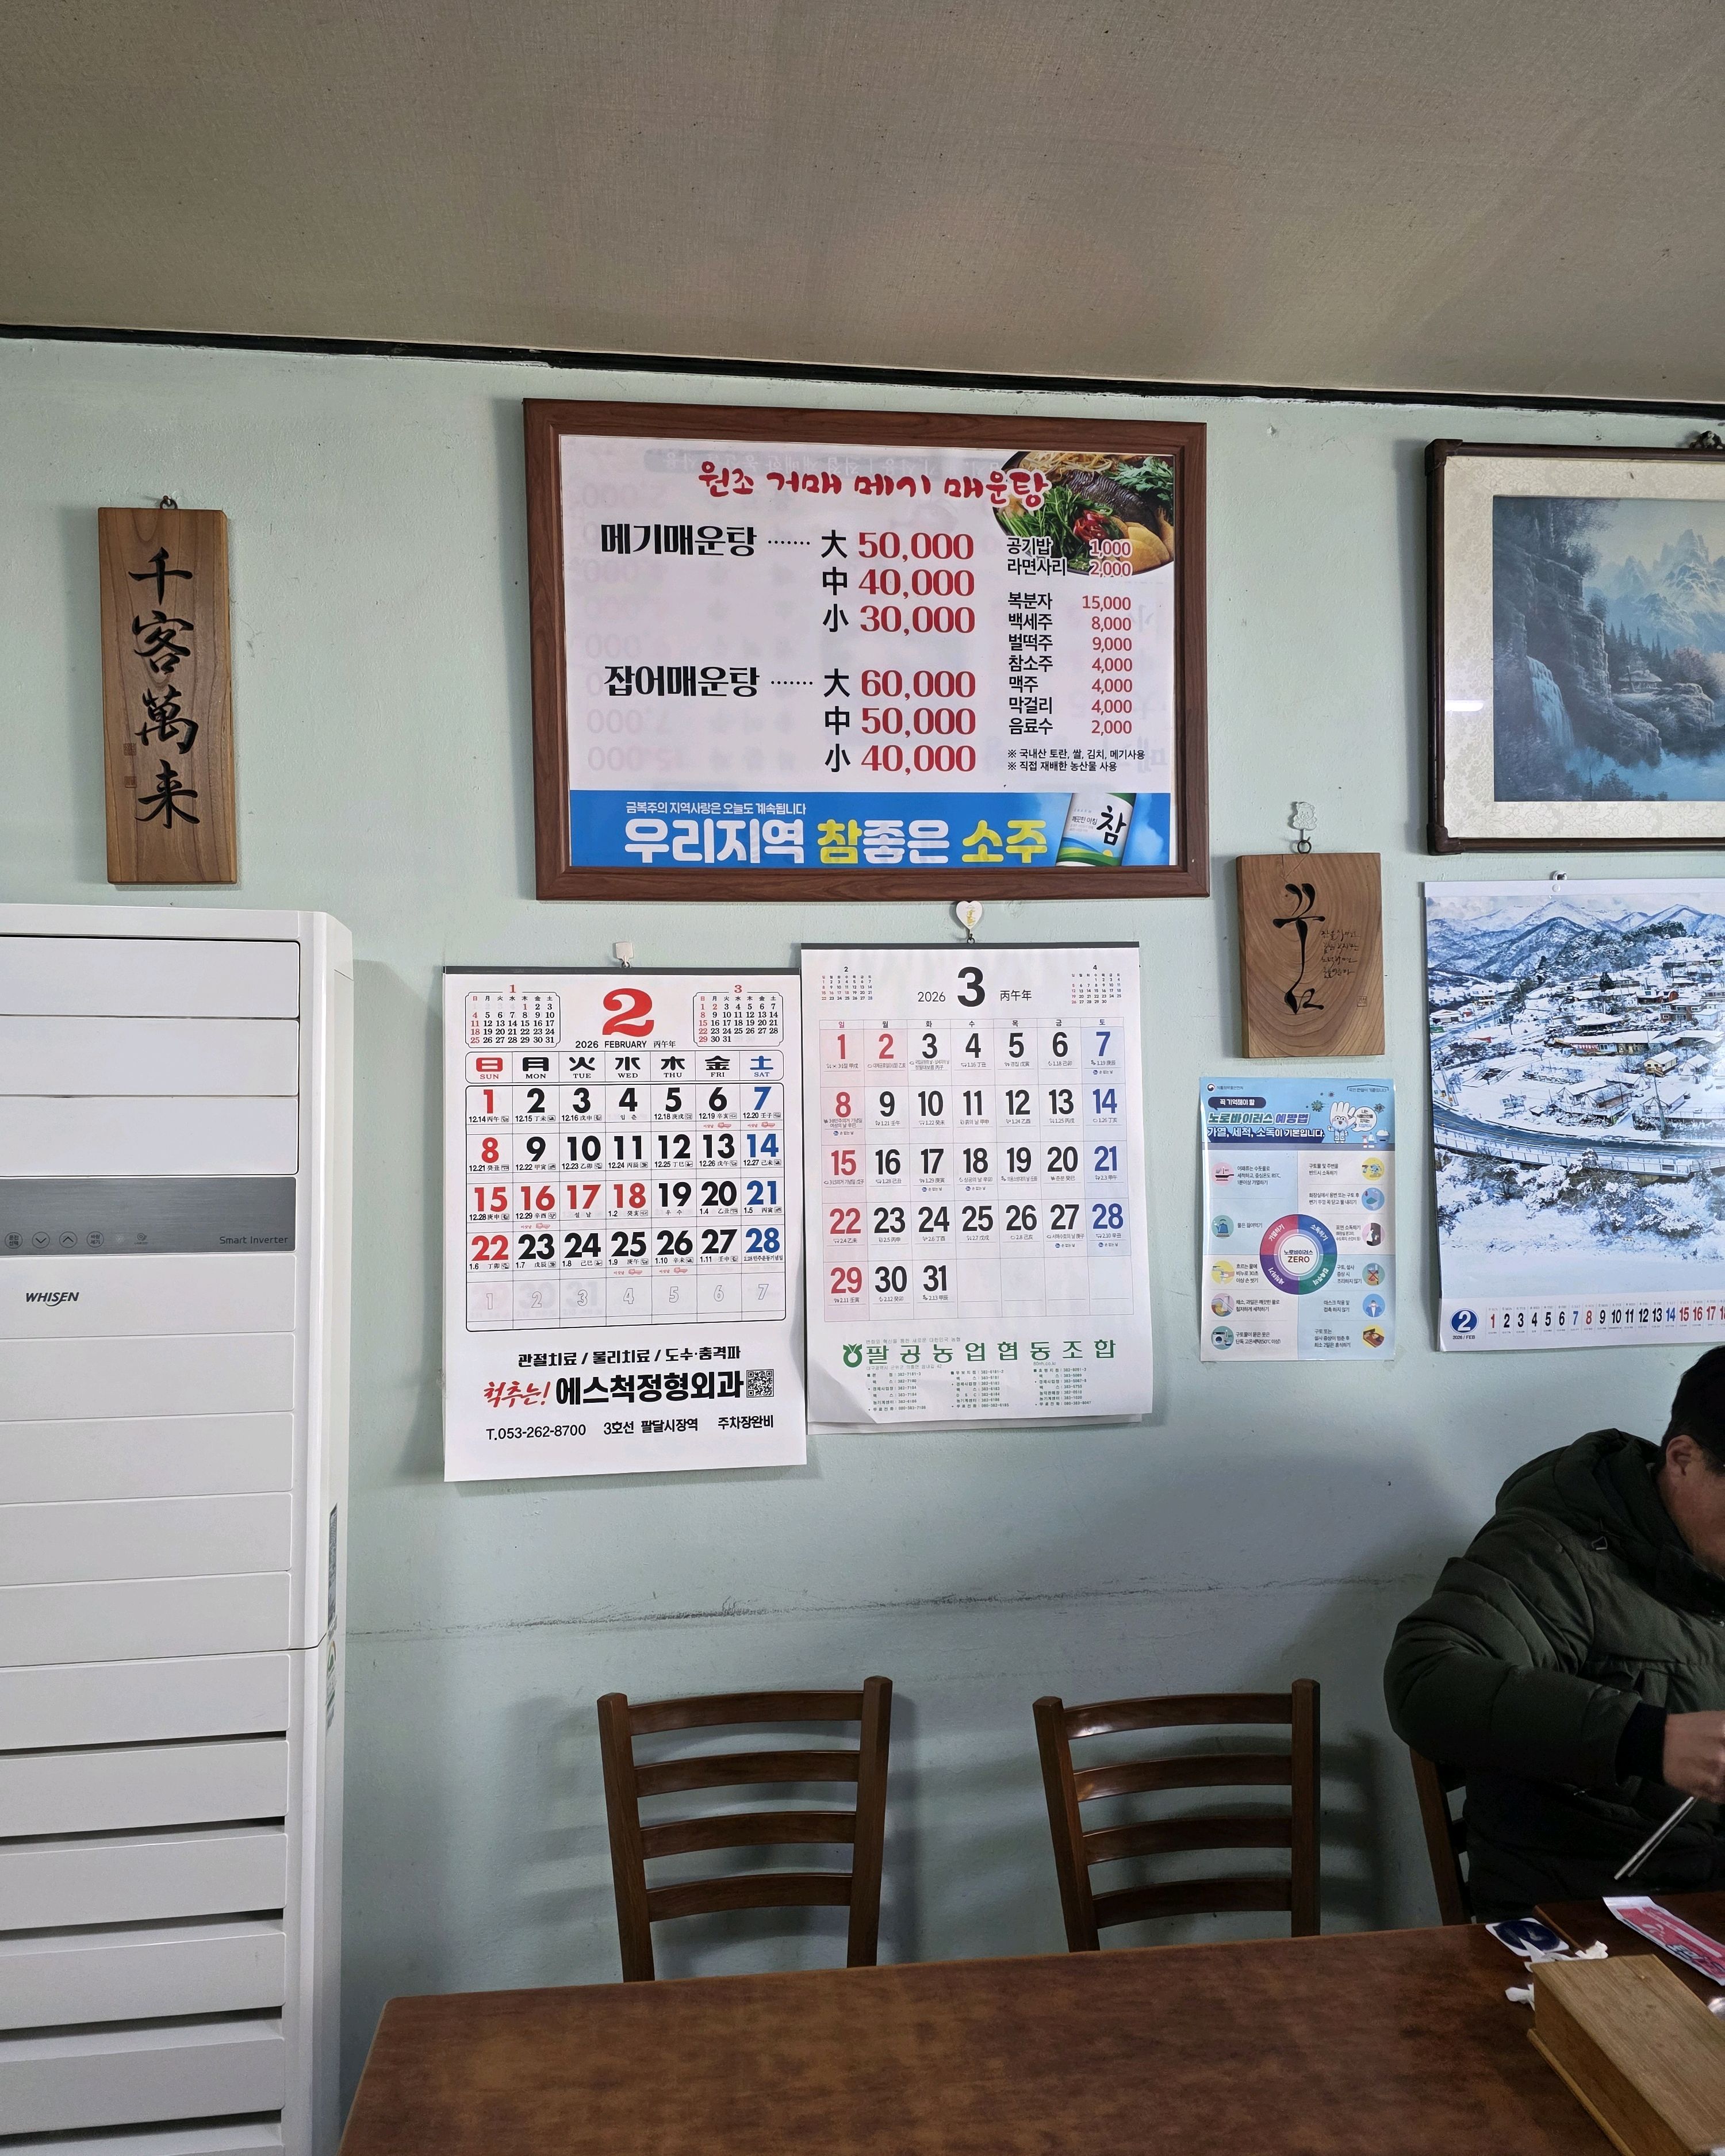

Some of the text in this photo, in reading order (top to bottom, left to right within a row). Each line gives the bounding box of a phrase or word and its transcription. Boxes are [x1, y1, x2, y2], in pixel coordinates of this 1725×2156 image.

[698, 461, 754, 497] 원조
[854, 473, 931, 498] 메기
[944, 471, 1048, 508] 매운탕
[601, 523, 757, 557] 메기매운탕
[821, 529, 848, 559] 大
[858, 532, 974, 562] 50,000
[1006, 537, 1052, 555] 공기밥
[1090, 540, 1131, 557] 1,000
[1007, 558, 1065, 576] 라면사리
[1091, 561, 1131, 577] 2,000
[822, 566, 848, 596] 中
[858, 569, 975, 600] 40,000
[1007, 592, 1053, 610] 복분자
[1082, 595, 1131, 612] 15,000
[822, 603, 849, 632] 小
[860, 605, 975, 636] 30,000
[1009, 612, 1053, 631] 백세주
[1091, 616, 1132, 632] 8,000
[1009, 633, 1053, 652] 벌떡주
[1092, 636, 1132, 653] 9,000
[1008, 654, 1053, 673] 참소주
[1091, 657, 1133, 674] 4,000
[604, 665, 760, 697] 잡어매운탕
[823, 668, 850, 698] 大
[861, 669, 976, 701] 60,000
[1009, 675, 1038, 693] 맥주
[1091, 678, 1133, 695] 4,000
[1009, 696, 1052, 715] 막걸리
[1091, 699, 1132, 716] 4,000
[825, 705, 850, 736] 中
[861, 707, 976, 738] 50,000
[1009, 718, 1053, 735] 음료수
[1091, 720, 1132, 736] 2,000
[825, 743, 851, 773] 小
[861, 745, 976, 776] 40,000
[1019, 748, 1145, 760] 국내산 토란, 쌀, 김치, 메기사용
[1019, 761, 1117, 772] 직접 재배한 농산물 사용
[626, 801, 807, 815] 금복주의 지역사랑은 오늘도 계속됩니다
[1097, 805, 1127, 846] 참
[624, 818, 1048, 864] 우리지역 참좋은 소주
[957, 966, 986, 1007] 3
[1000, 989, 1032, 1002] 丙午年
[917, 991, 946, 1002] 2026
[602, 988, 654, 1038] 2
[838, 1020, 845, 1028] 일
[882, 1021, 889, 1029] 월
[1055, 1019, 1062, 1027] 금
[575, 1040, 599, 1049] 2026
[604, 1041, 647, 1049] FEBRUARY
[837, 1033, 846, 1060] 1
[878, 1033, 894, 1060] 2
[922, 1033, 938, 1059] 3
[965, 1033, 982, 1058] 4
[1009, 1032, 1025, 1058] 5
[1052, 1031, 1068, 1057] 6
[1096, 1031, 1111, 1057] 7
[476, 1057, 503, 1072] 日
[522, 1057, 549, 1072] 月
[569, 1056, 596, 1072] 火
[615, 1056, 641, 1071] 水
[661, 1056, 685, 1071] 木
[704, 1055, 731, 1071] 金
[750, 1055, 774, 1070] 土
[483, 1089, 494, 1114] 1
[527, 1087, 545, 1114] 2
[572, 1087, 591, 1114] 3
[619, 1087, 638, 1112] 4
[665, 1087, 682, 1112] 5
[708, 1087, 727, 1112] 6
[753, 1086, 772, 1111] 7
[1208, 1112, 1309, 1124] 노로바이러스 예방법
[1208, 1127, 1325, 1138] 가열, 세척, 소독이 기본입니다.
[219, 1236, 289, 1244] Smart Inverter
[26, 1292, 80, 1307] WHISEN
[1457, 1310, 1471, 1332] 2
[518, 1352, 577, 1368] 관절치료
[592, 1349, 650, 1364] 물리치료
[865, 1339, 1117, 1364] 팔공농업협동조합
[483, 1380, 551, 1408] 척추는!
[555, 1370, 744, 1405] 에스척정형외과
[603, 1418, 698, 1435] 3호선 팔달시장역
[718, 1414, 773, 1430] 주차장완비
[486, 1424, 586, 1441] T.053-262-8700
